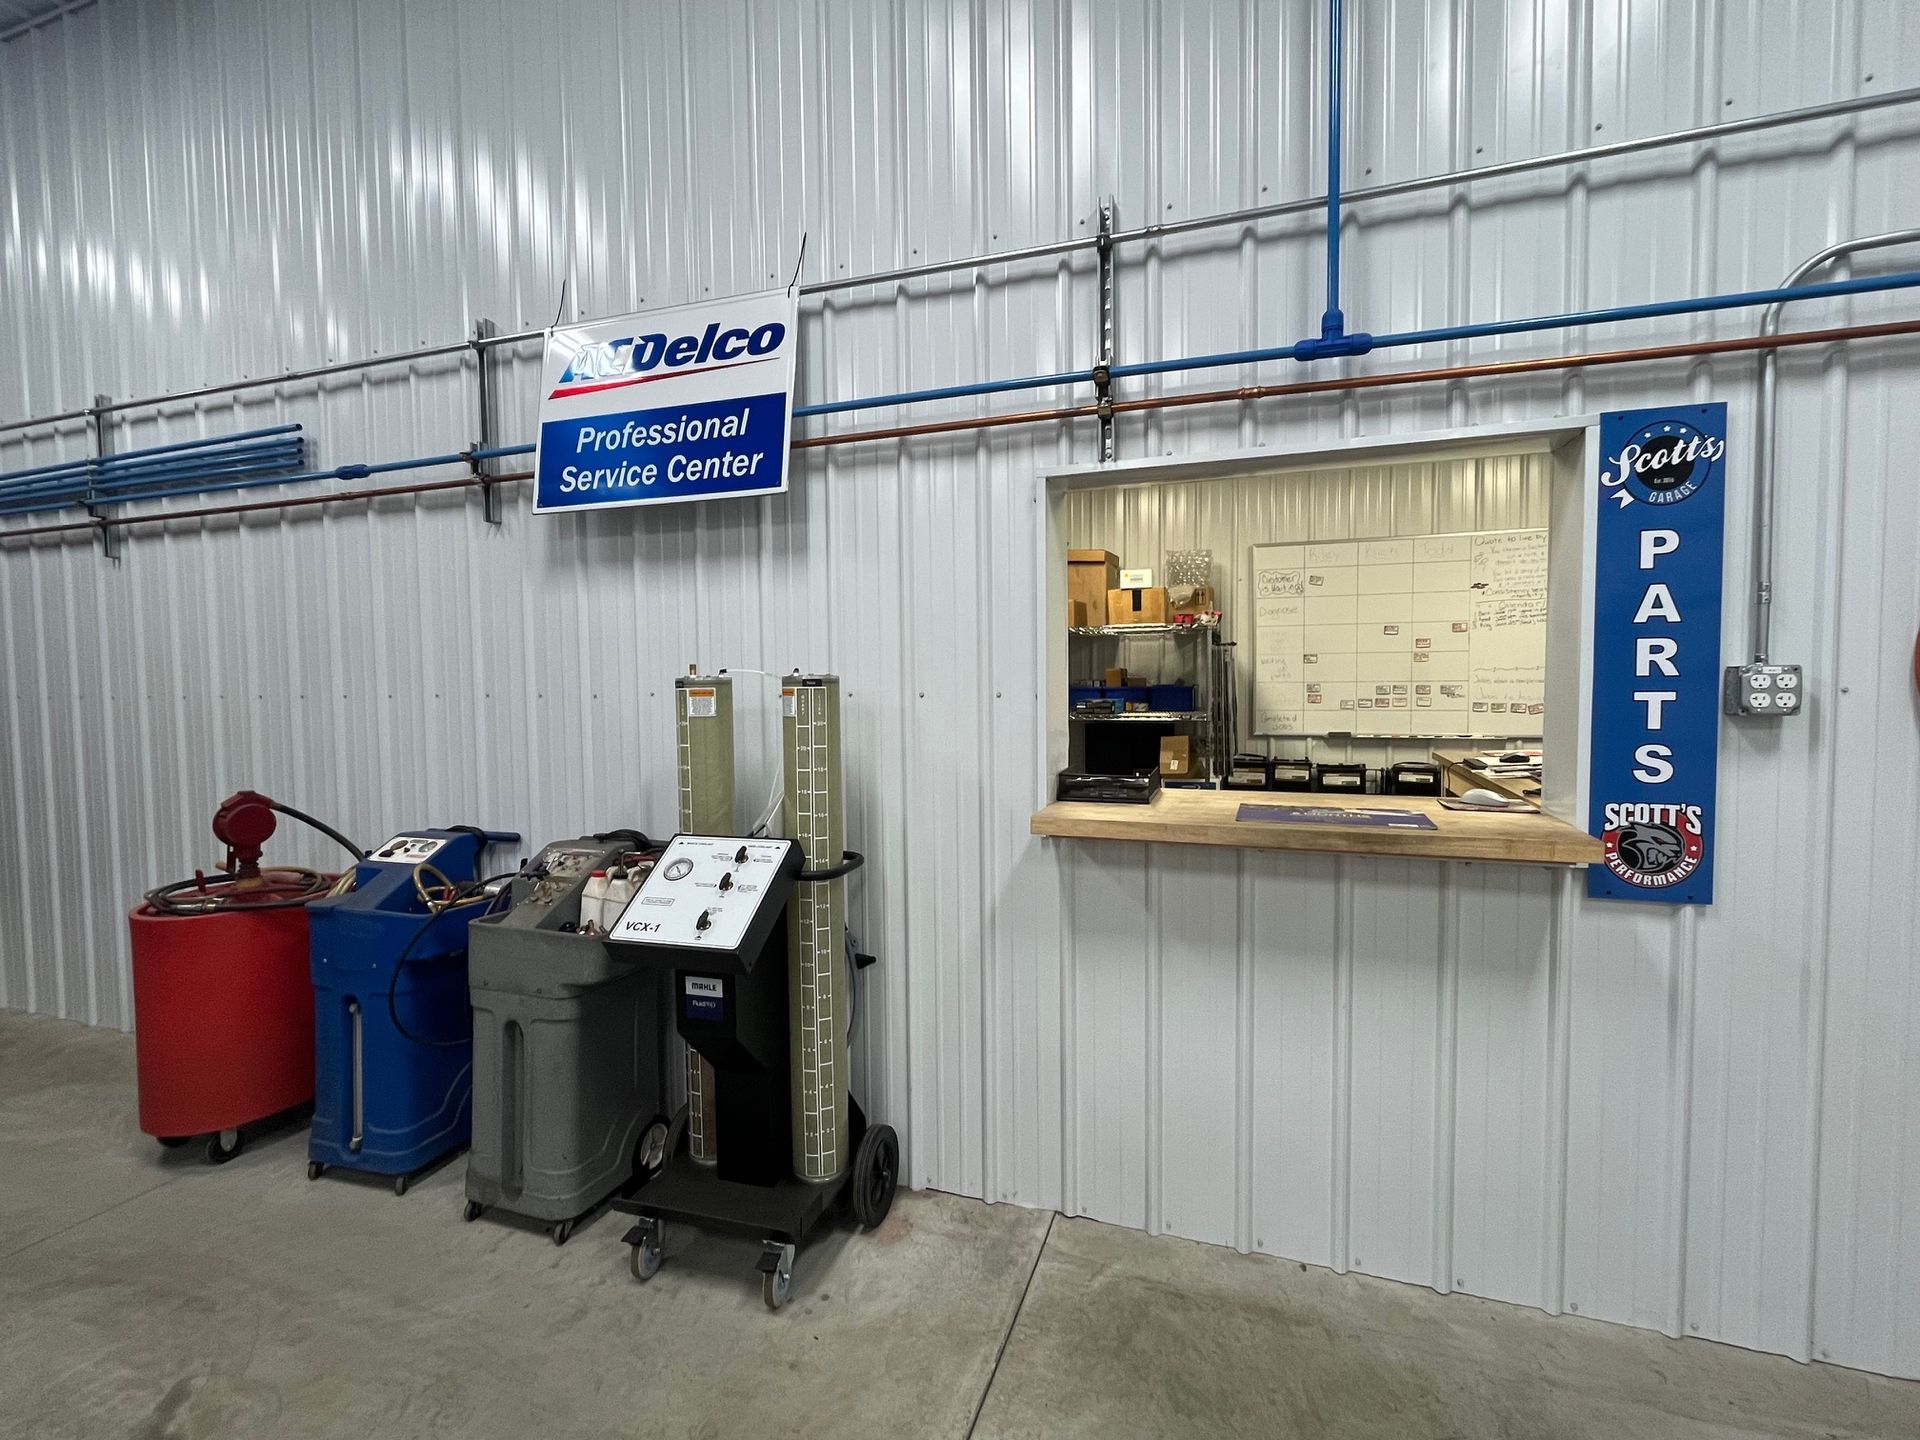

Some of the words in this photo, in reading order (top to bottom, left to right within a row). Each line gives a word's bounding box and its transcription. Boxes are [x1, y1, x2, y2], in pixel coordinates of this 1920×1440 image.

[558, 322, 786, 384] ACDelco
[576, 407, 750, 454] Professional
[559, 460, 658, 493] Service
[667, 451, 764, 483] Center
[1648, 480, 1698, 503] GARAGE
[1632, 529, 1682, 784] PARTS
[1604, 802, 1702, 836] SCOTT'S
[1604, 852, 1698, 887] PERFORMANCE
[625, 921, 662, 932] VCX-1
[691, 982, 718, 992] MAHLE
